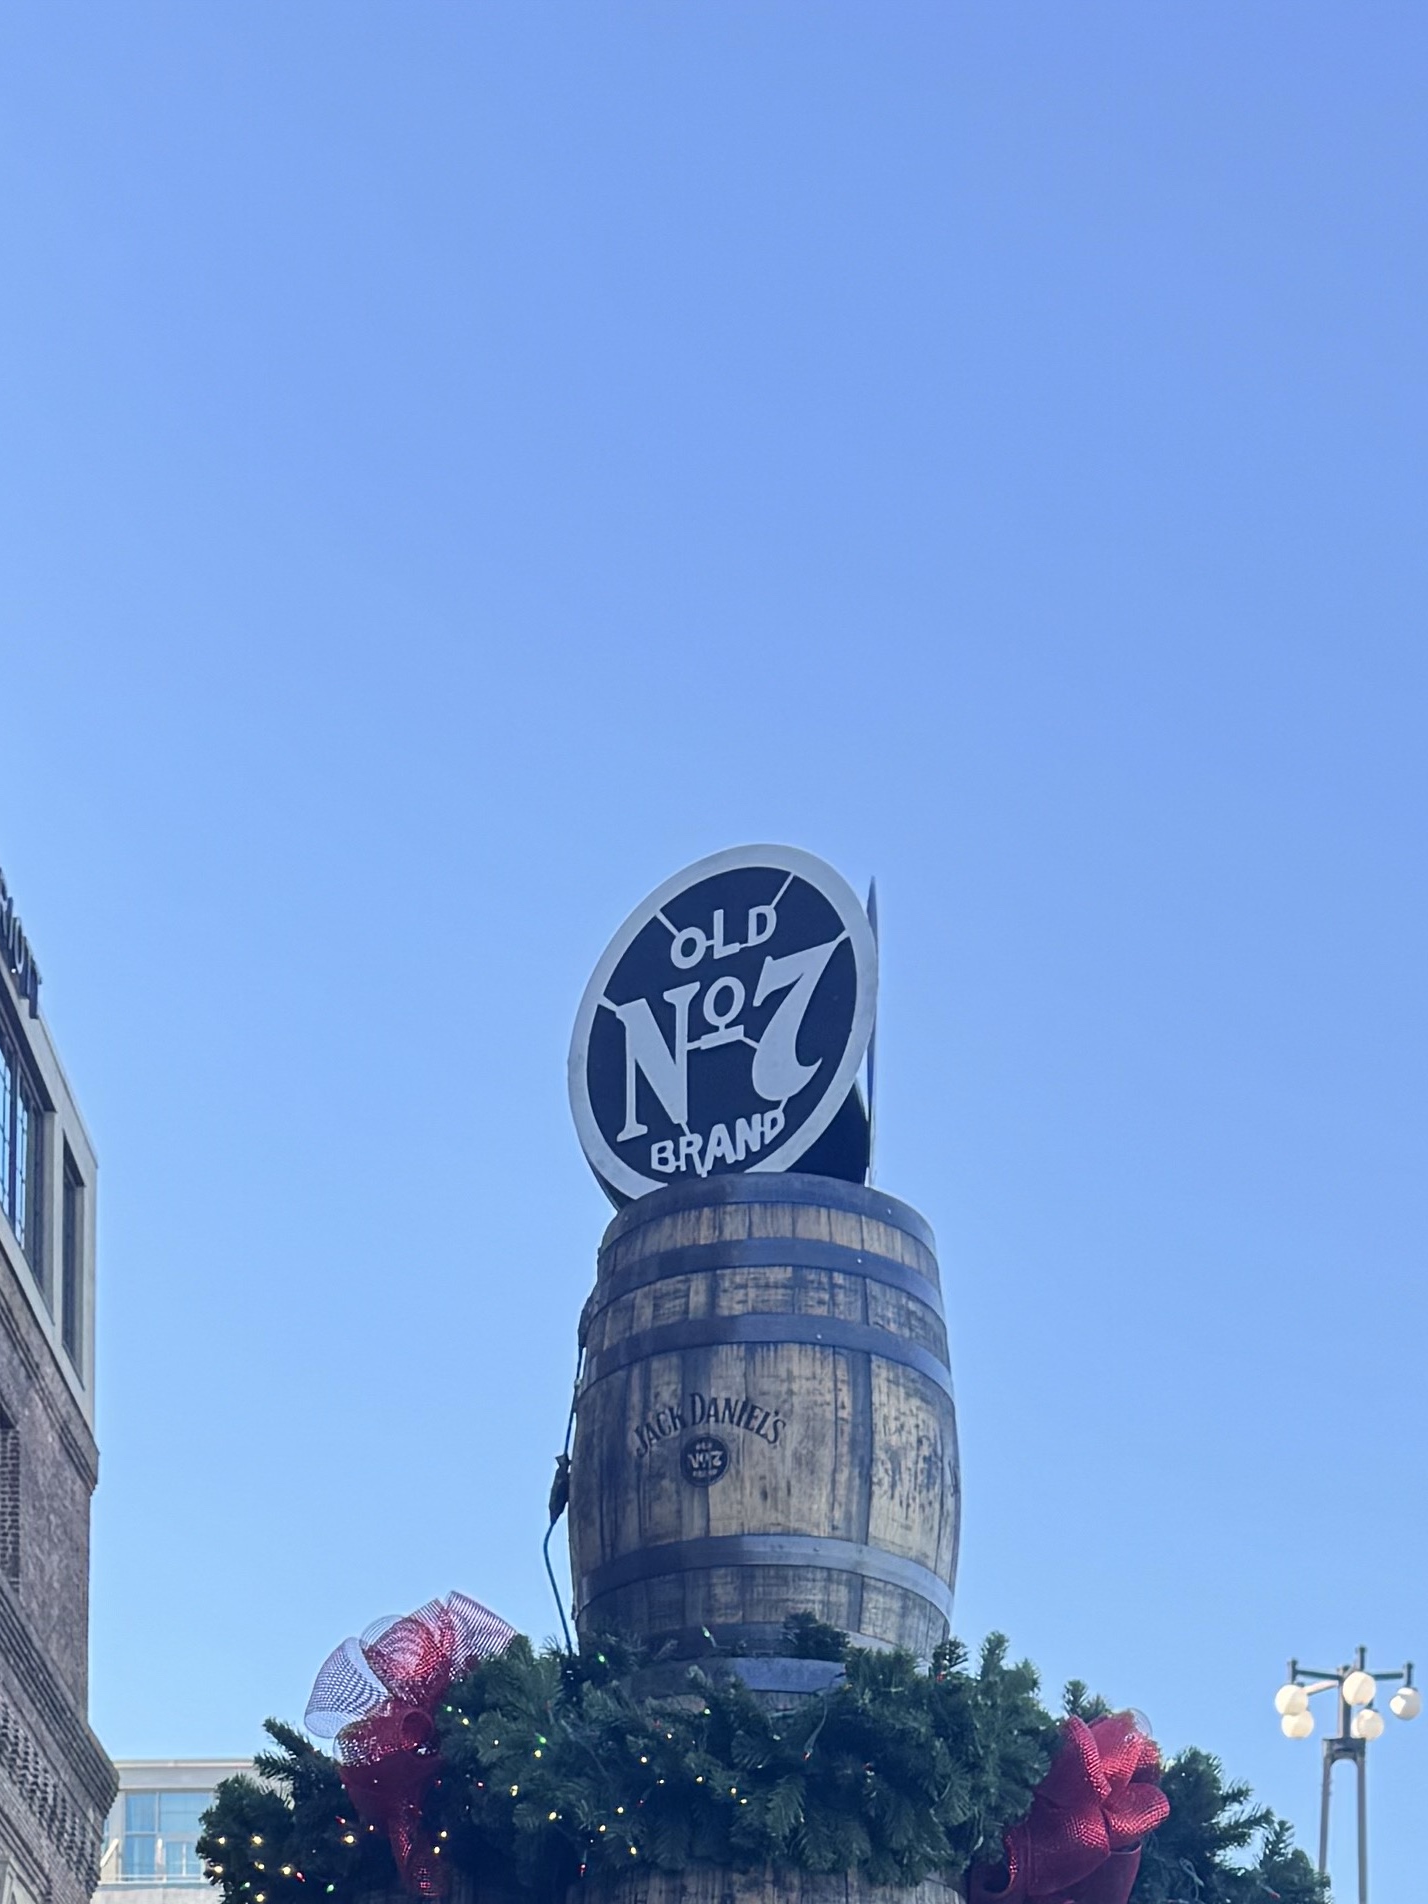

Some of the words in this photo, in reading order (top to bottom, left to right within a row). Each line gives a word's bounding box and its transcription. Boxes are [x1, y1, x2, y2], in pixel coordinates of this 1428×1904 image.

[670, 905, 777, 969] OLD
[651, 1109, 785, 1178] BRAND
[635, 1405, 685, 1458] JACK
[689, 1392, 787, 1446] DANIEL'S
